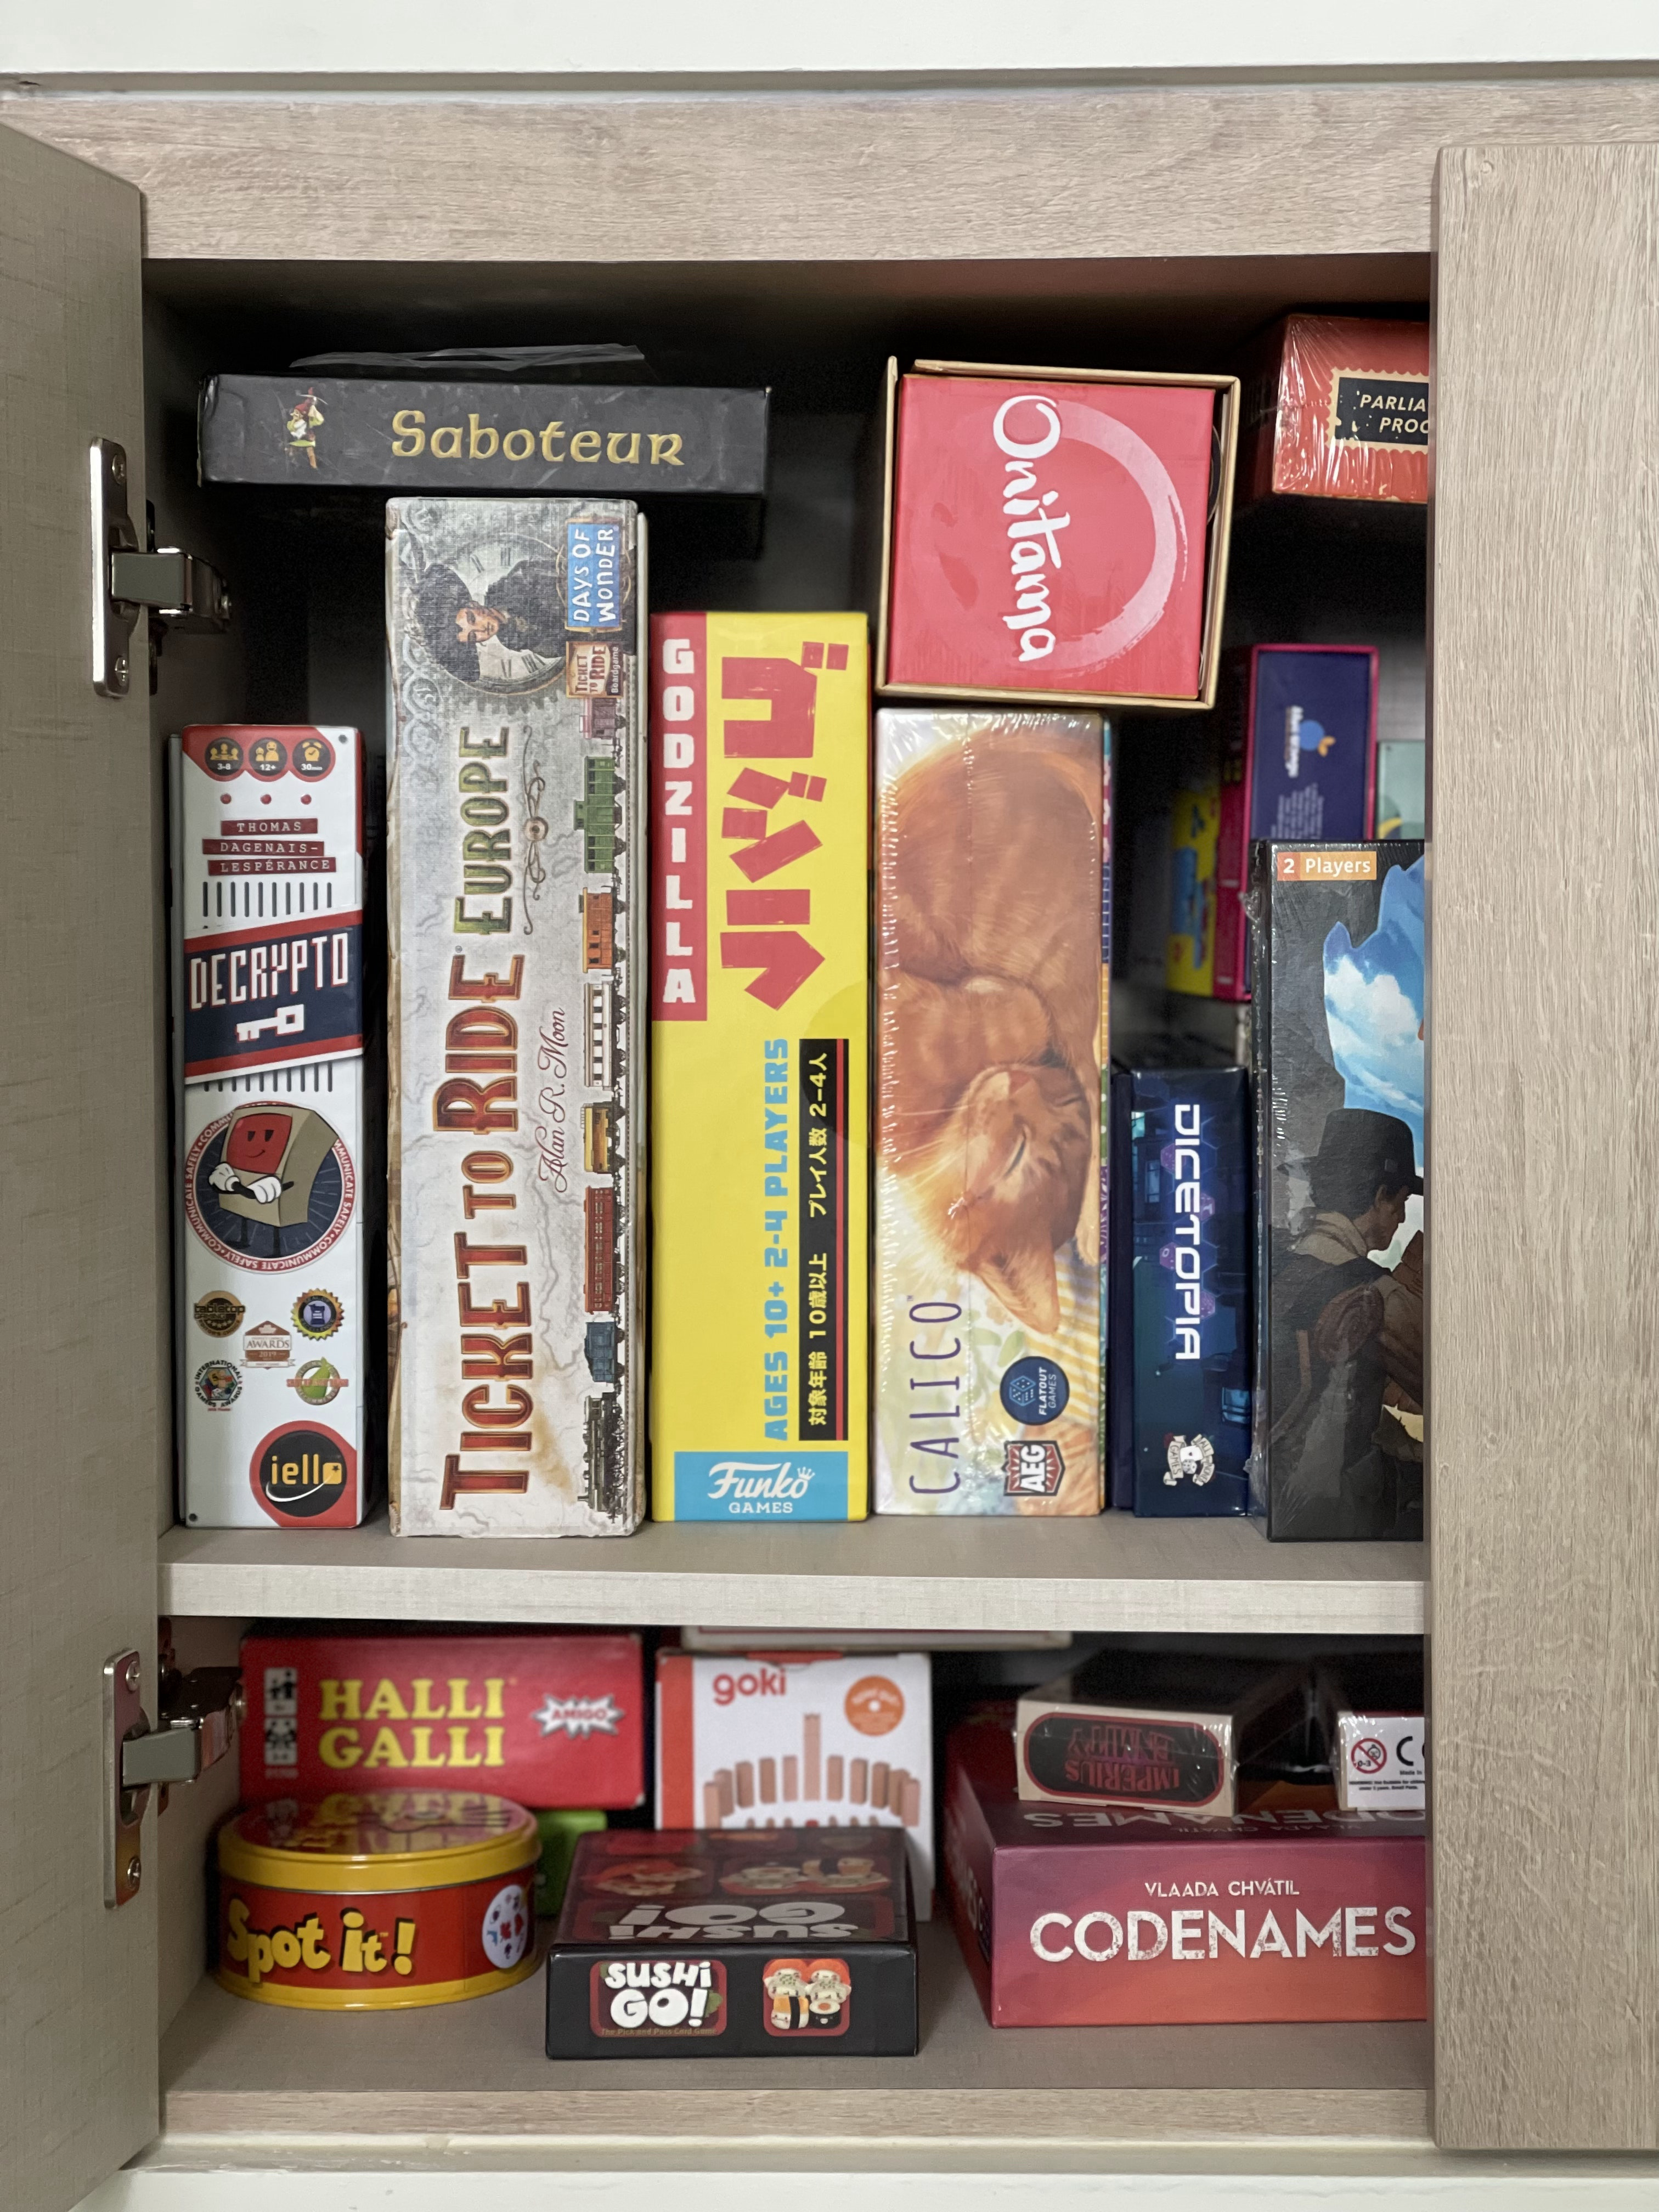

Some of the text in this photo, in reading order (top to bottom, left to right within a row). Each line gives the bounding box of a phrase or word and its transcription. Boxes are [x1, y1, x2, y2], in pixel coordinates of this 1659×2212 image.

[391, 410, 685, 466] Saboteur
[993, 395, 1070, 662] Onitama
[572, 529, 592, 622] DAYS OF
[596, 528, 616, 622] WONDER
[575, 654, 588, 693] TICKET
[589, 646, 606, 693] TO RIDE
[610, 646, 619, 693] Boardgame
[236, 822, 302, 833] THOMAS
[663, 639, 696, 1003] GODZILLA
[720, 641, 849, 1011] ゴジラ
[221, 859, 330, 873] LESPÉRANCE
[1283, 856, 1371, 874] 2 Players
[190, 933, 348, 1010] DECRYPTO
[433, 727, 533, 1510] TICKET TO RIDE EUROPE
[535, 1007, 569, 1193] Alan R. Moon
[185, 1146, 201, 1180] SAFELY
[809, 1127, 827, 1217] プレイ人数
[335, 1201, 352, 1235] SAFELY
[765, 1039, 788, 1441] AGES 10+ 2-4 PLAYERS
[1175, 1104, 1200, 1359] DICETOPIA
[194, 1303, 246, 1314] tabletop
[809, 1252, 827, 1339] 10歳以上
[246, 1340, 290, 1348] AWARDS
[194, 1359, 243, 1380] INTERNATIONAL
[809, 1351, 827, 1426] 対象年齢
[1039, 1367, 1049, 1415] FLATOUT
[909, 1302, 962, 1494] CALICO
[272, 1453, 342, 1485] iello
[707, 1462, 809, 1499] Funko
[1020, 1444, 1046, 1493] AEG
[1170, 1444, 1182, 1475] GAMES
[729, 1502, 793, 1514] GAMES
[319, 1679, 504, 1720] HALLI
[713, 1668, 786, 1705] goki
[551, 1708, 607, 1720] AMIGO
[318, 1726, 505, 1769] GALLI
[1064, 1759, 1180, 1792] IMPERIUS
[1145, 1877, 1300, 1898] VLAADA CHVÁTIL
[619, 1902, 845, 1925] GO!
[1030, 1906, 1417, 1963] CODENAMES
[227, 1898, 416, 1983] Spot it!
[610, 1988, 708, 2028] GO!
